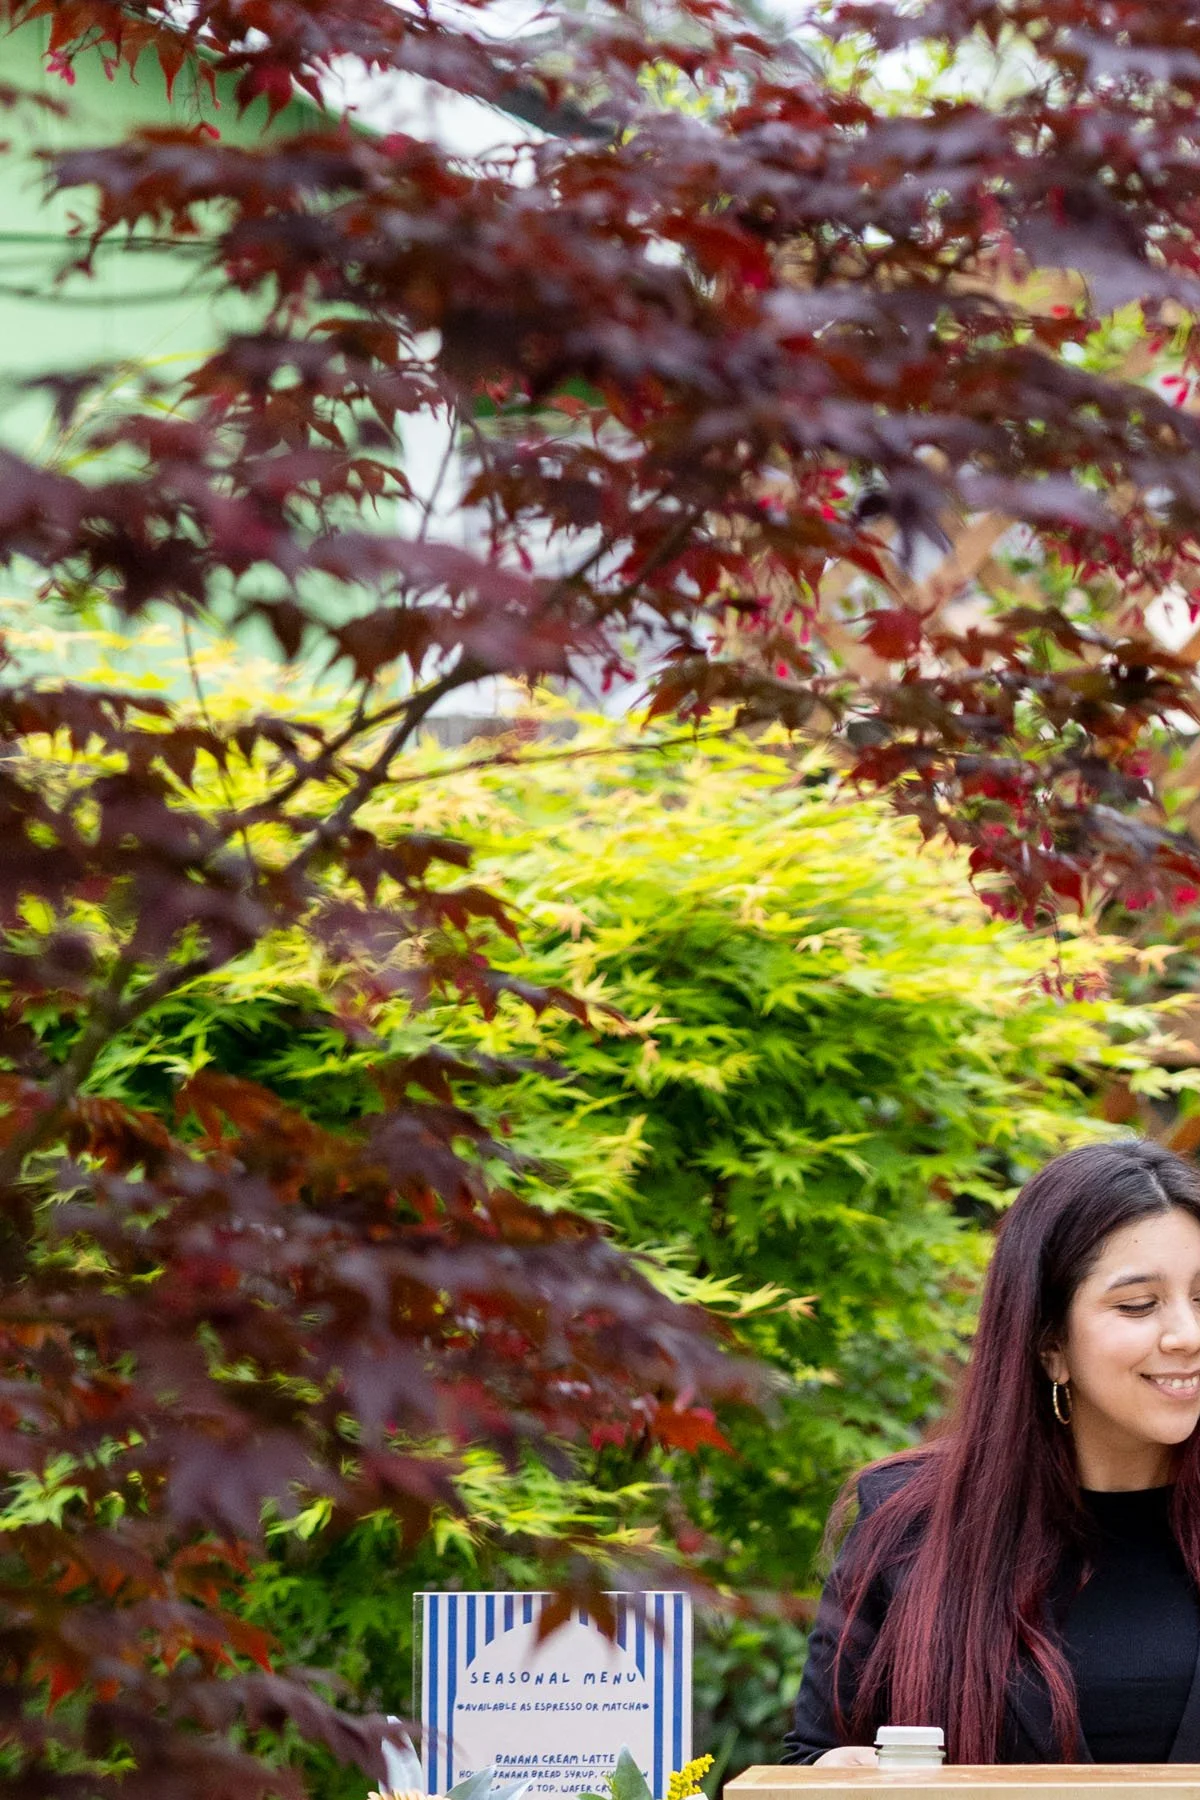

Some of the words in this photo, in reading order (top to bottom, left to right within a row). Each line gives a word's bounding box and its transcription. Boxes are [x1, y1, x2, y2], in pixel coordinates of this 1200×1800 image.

[470, 1671, 571, 1685] SEASONAL
[583, 1671, 637, 1685] MENU
[519, 1702, 532, 1712] AS
[534, 1702, 583, 1712] ESPRESSO
[586, 1702, 599, 1712] OR
[495, 1754, 539, 1764] BANANA
[541, 1754, 579, 1764] CREAM
[582, 1754, 615, 1764] LATTE
[531, 1770, 561, 1779] BREAD
[561, 1784, 592, 1793] WAFER
